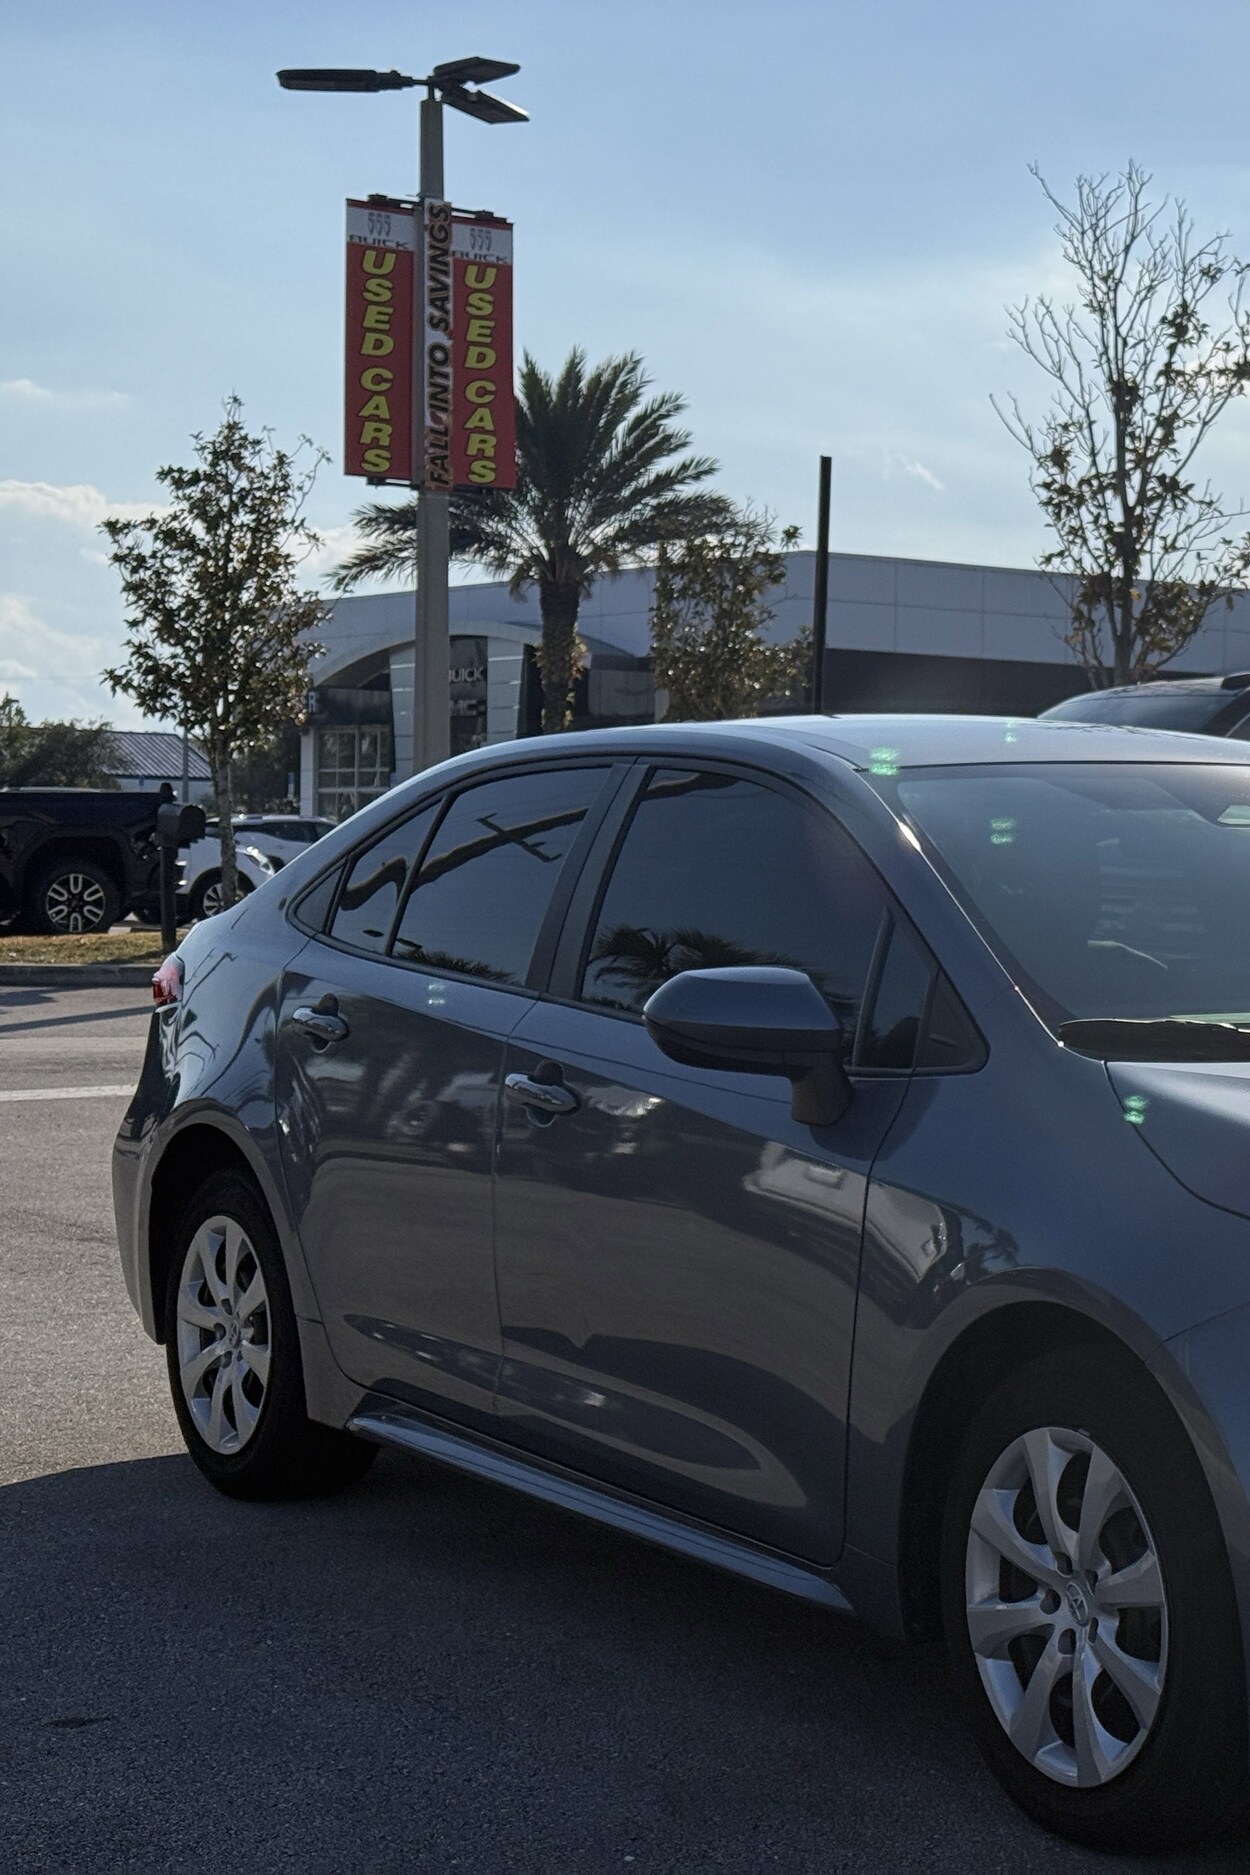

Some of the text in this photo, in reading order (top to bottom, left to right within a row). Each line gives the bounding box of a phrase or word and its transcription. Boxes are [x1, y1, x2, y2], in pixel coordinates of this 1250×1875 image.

[358, 249, 397, 473] USED CARS
[428, 202, 449, 486] FALL INTO SAVINGS
[464, 264, 498, 484] USED CARS
